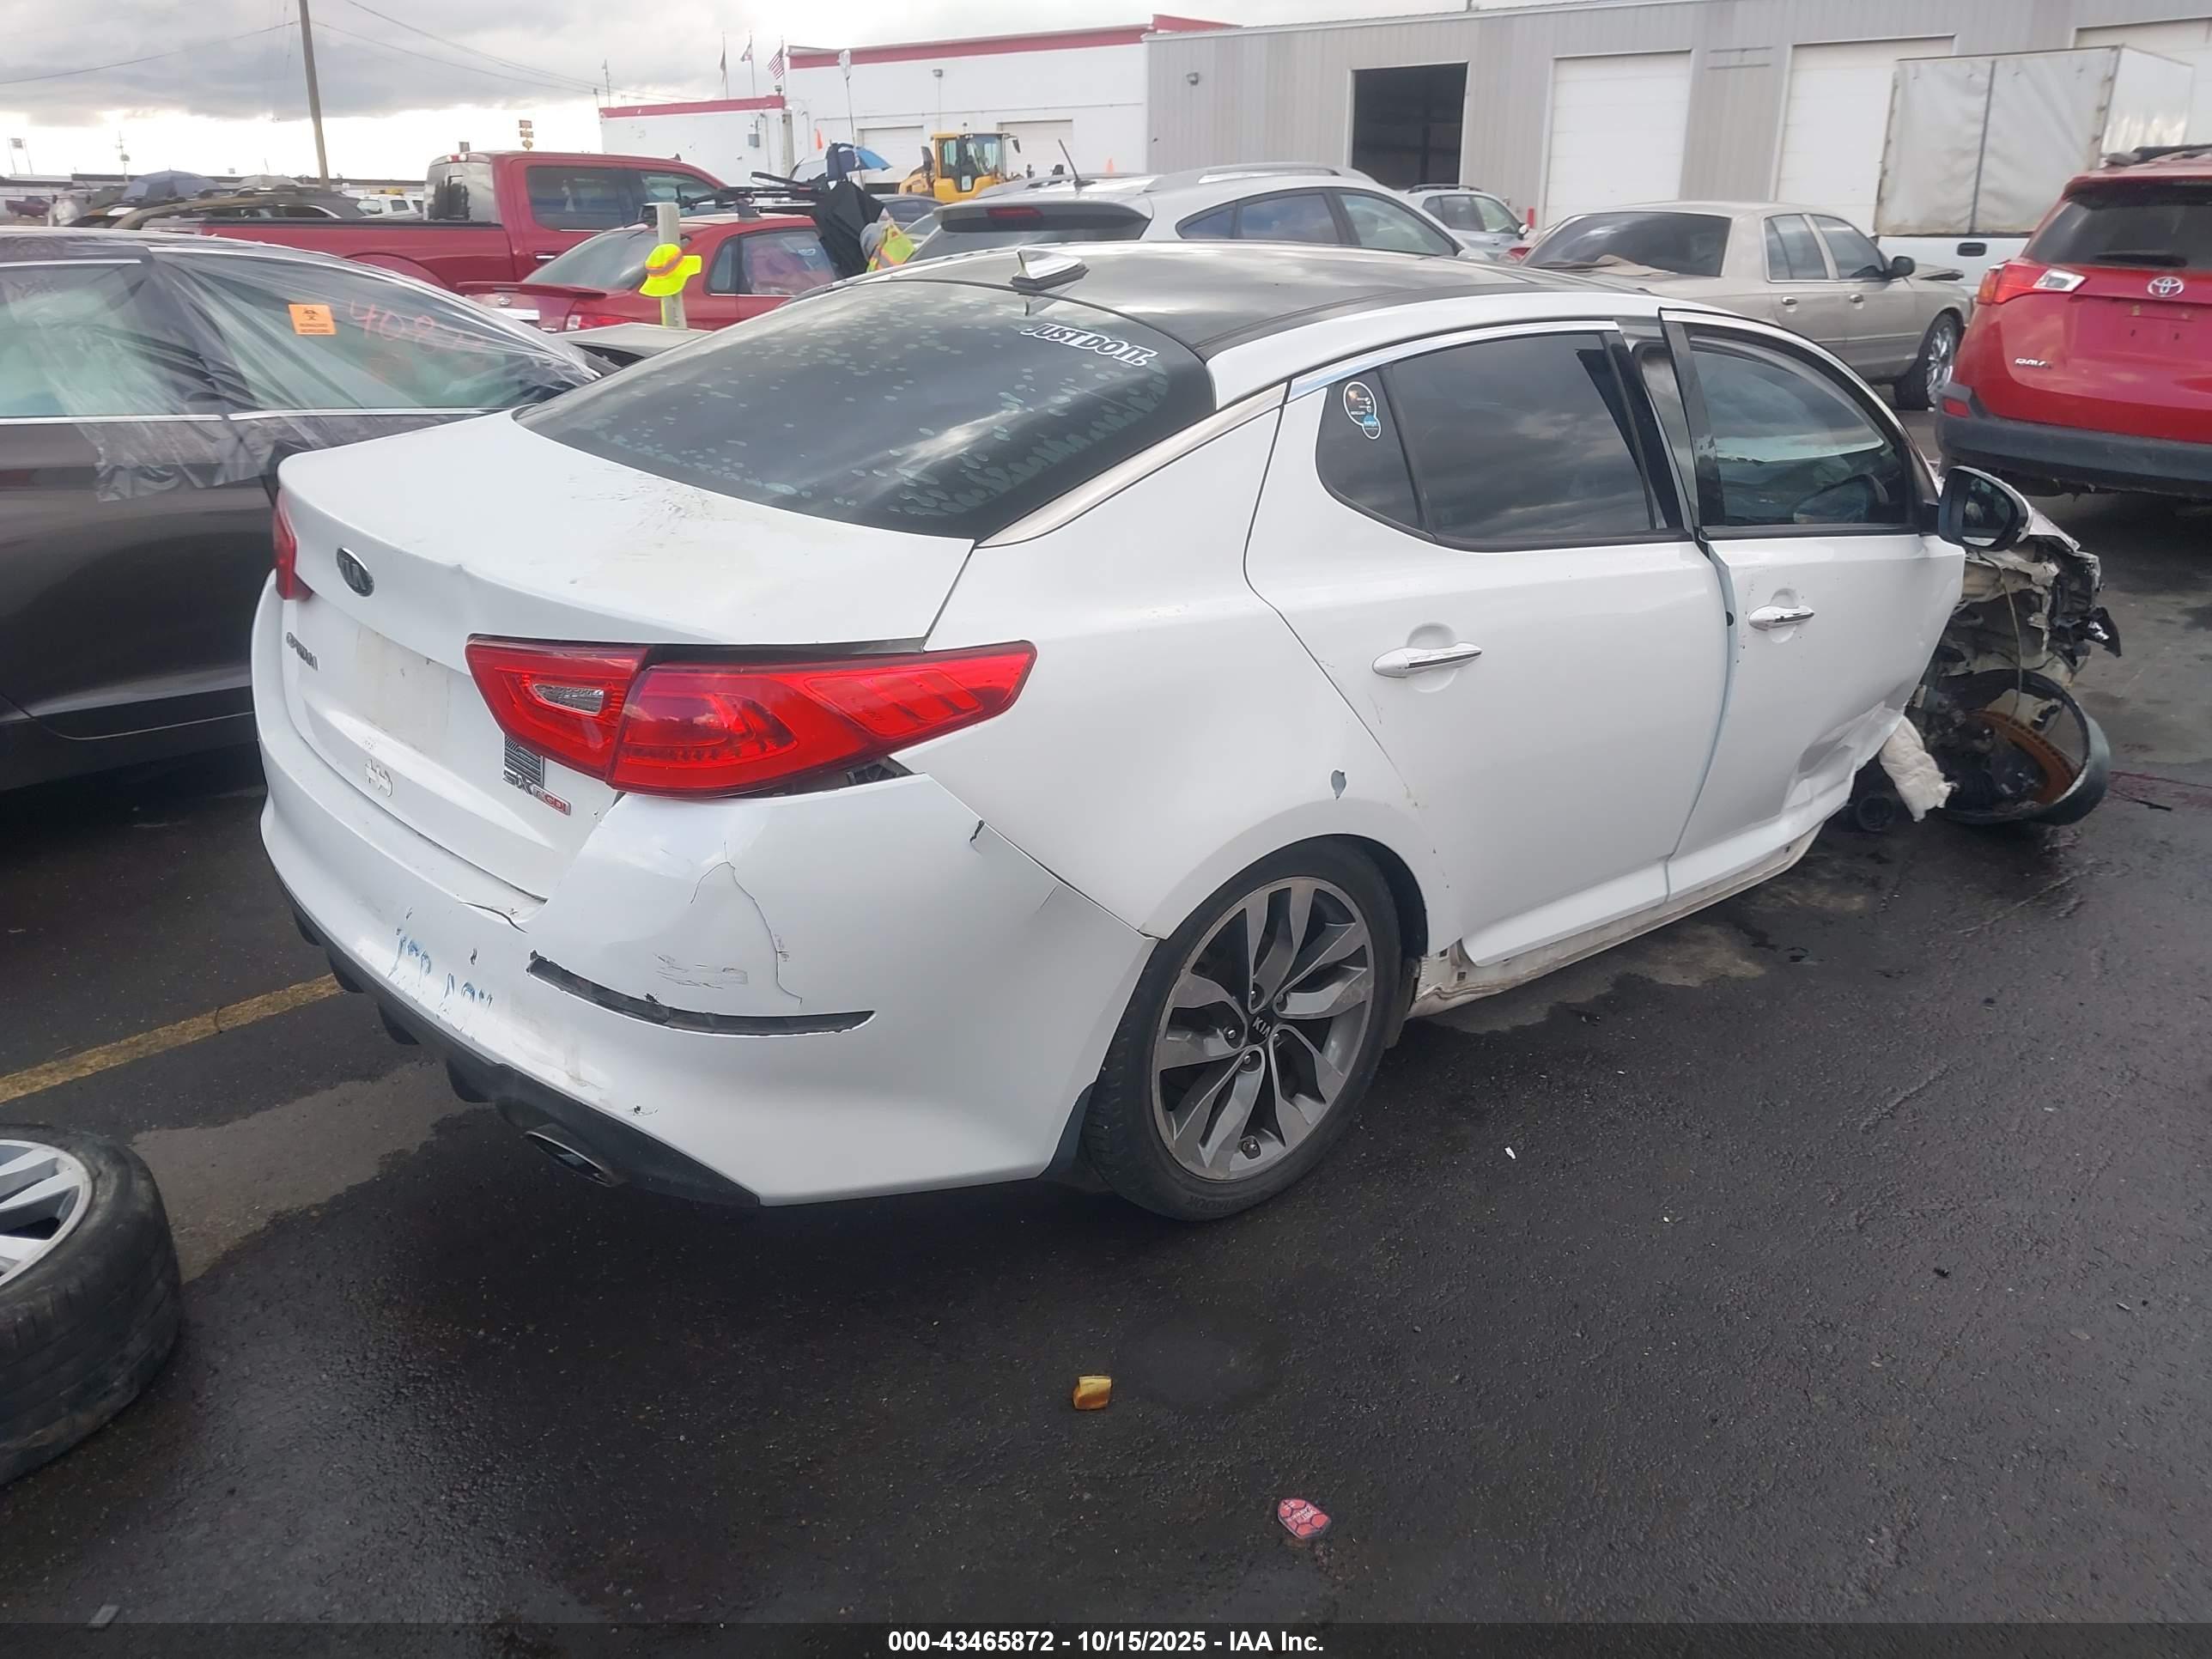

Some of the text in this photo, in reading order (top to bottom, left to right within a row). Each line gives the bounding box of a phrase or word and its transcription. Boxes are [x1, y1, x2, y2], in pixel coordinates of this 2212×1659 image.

[1020, 323, 1092, 344] JUST
[1076, 332, 1129, 356] DO
[1252, 1016, 1271, 1038] KIA
